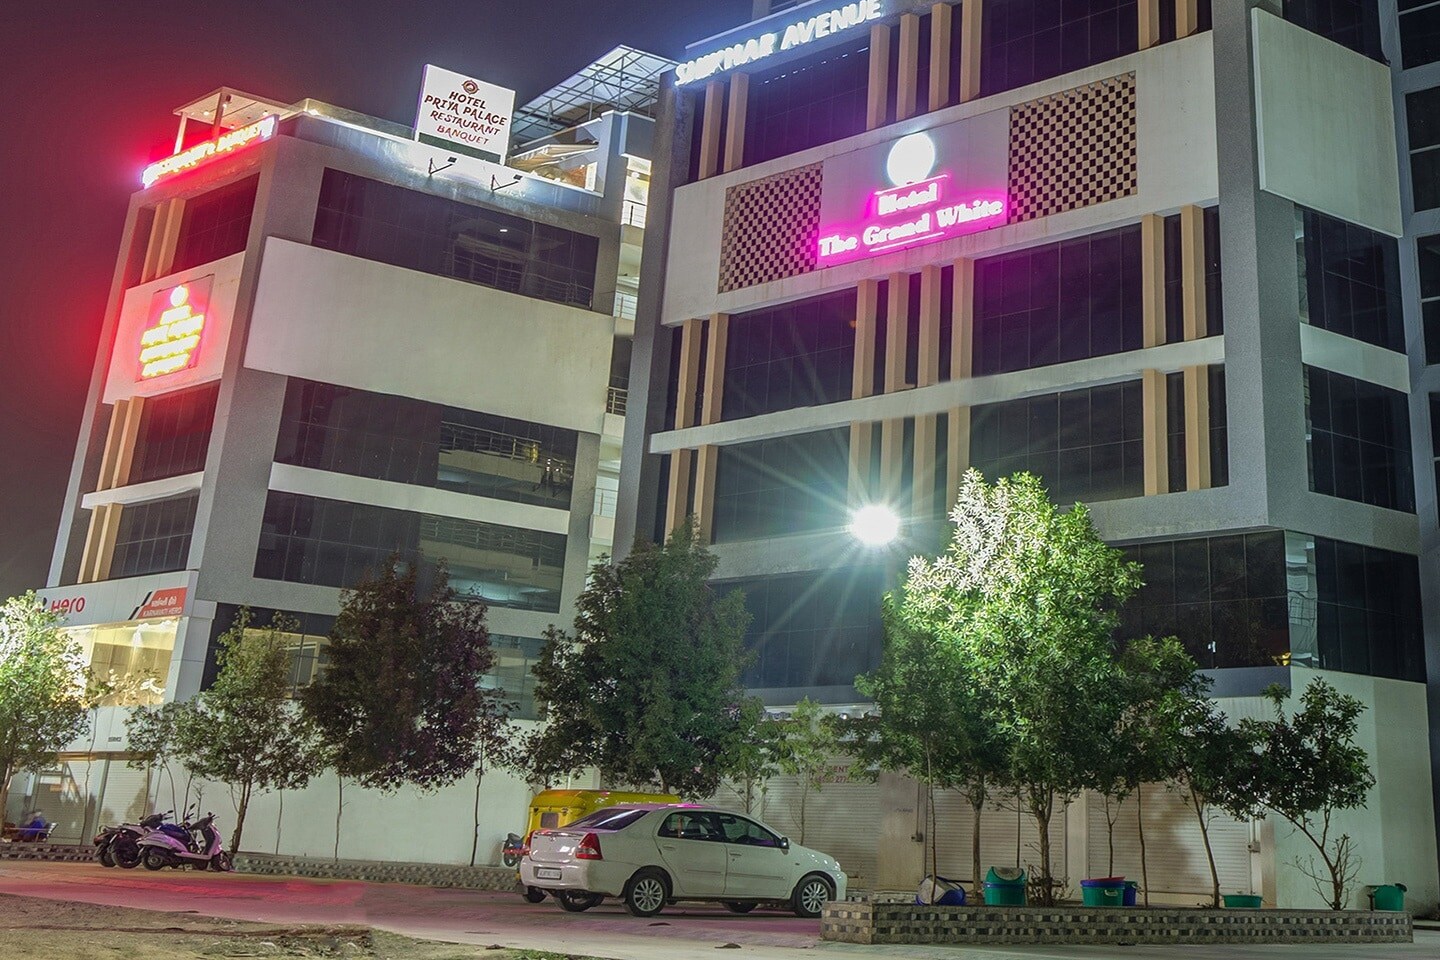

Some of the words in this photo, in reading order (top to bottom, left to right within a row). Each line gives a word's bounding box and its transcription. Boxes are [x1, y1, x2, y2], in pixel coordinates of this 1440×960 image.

[424, 95, 459, 115] PRIYA
[463, 106, 507, 126] PALACE
[448, 91, 486, 109] HOTEL
[430, 110, 500, 135] RESTAURANT
[437, 125, 489, 145] BANQUET
[877, 183, 938, 215] Hotel
[818, 235, 858, 257] The
[862, 213, 930, 246] Grand
[936, 200, 1003, 228] White
